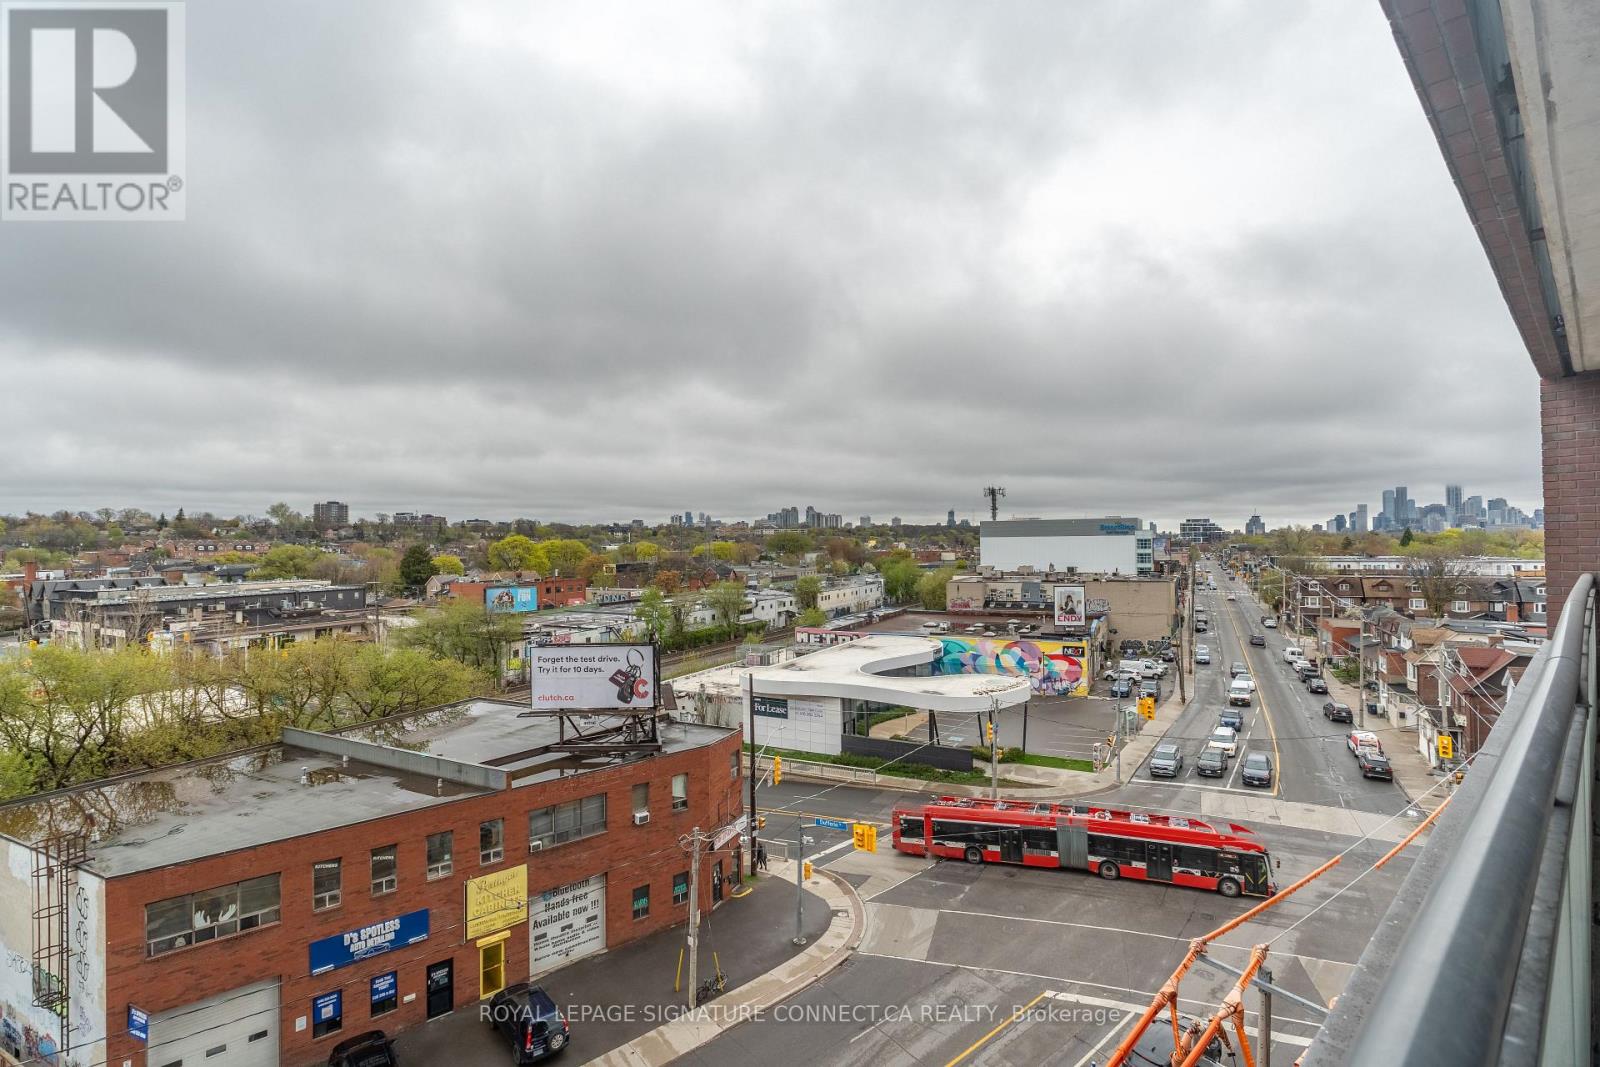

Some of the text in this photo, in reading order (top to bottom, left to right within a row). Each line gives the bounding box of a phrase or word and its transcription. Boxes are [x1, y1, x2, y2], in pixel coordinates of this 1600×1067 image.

[537, 655, 564, 664] Forget
[565, 655, 579, 663] the
[538, 666, 550, 674] Try
[583, 665, 605, 674] days.
[754, 702, 766, 712] For
[767, 703, 787, 715] Lease
[552, 879, 590, 897] Bluetooth
[532, 909, 570, 930] Available
[572, 905, 589, 916] now
[590, 899, 599, 910] !!!
[360, 918, 401, 941] SPOTLESS
